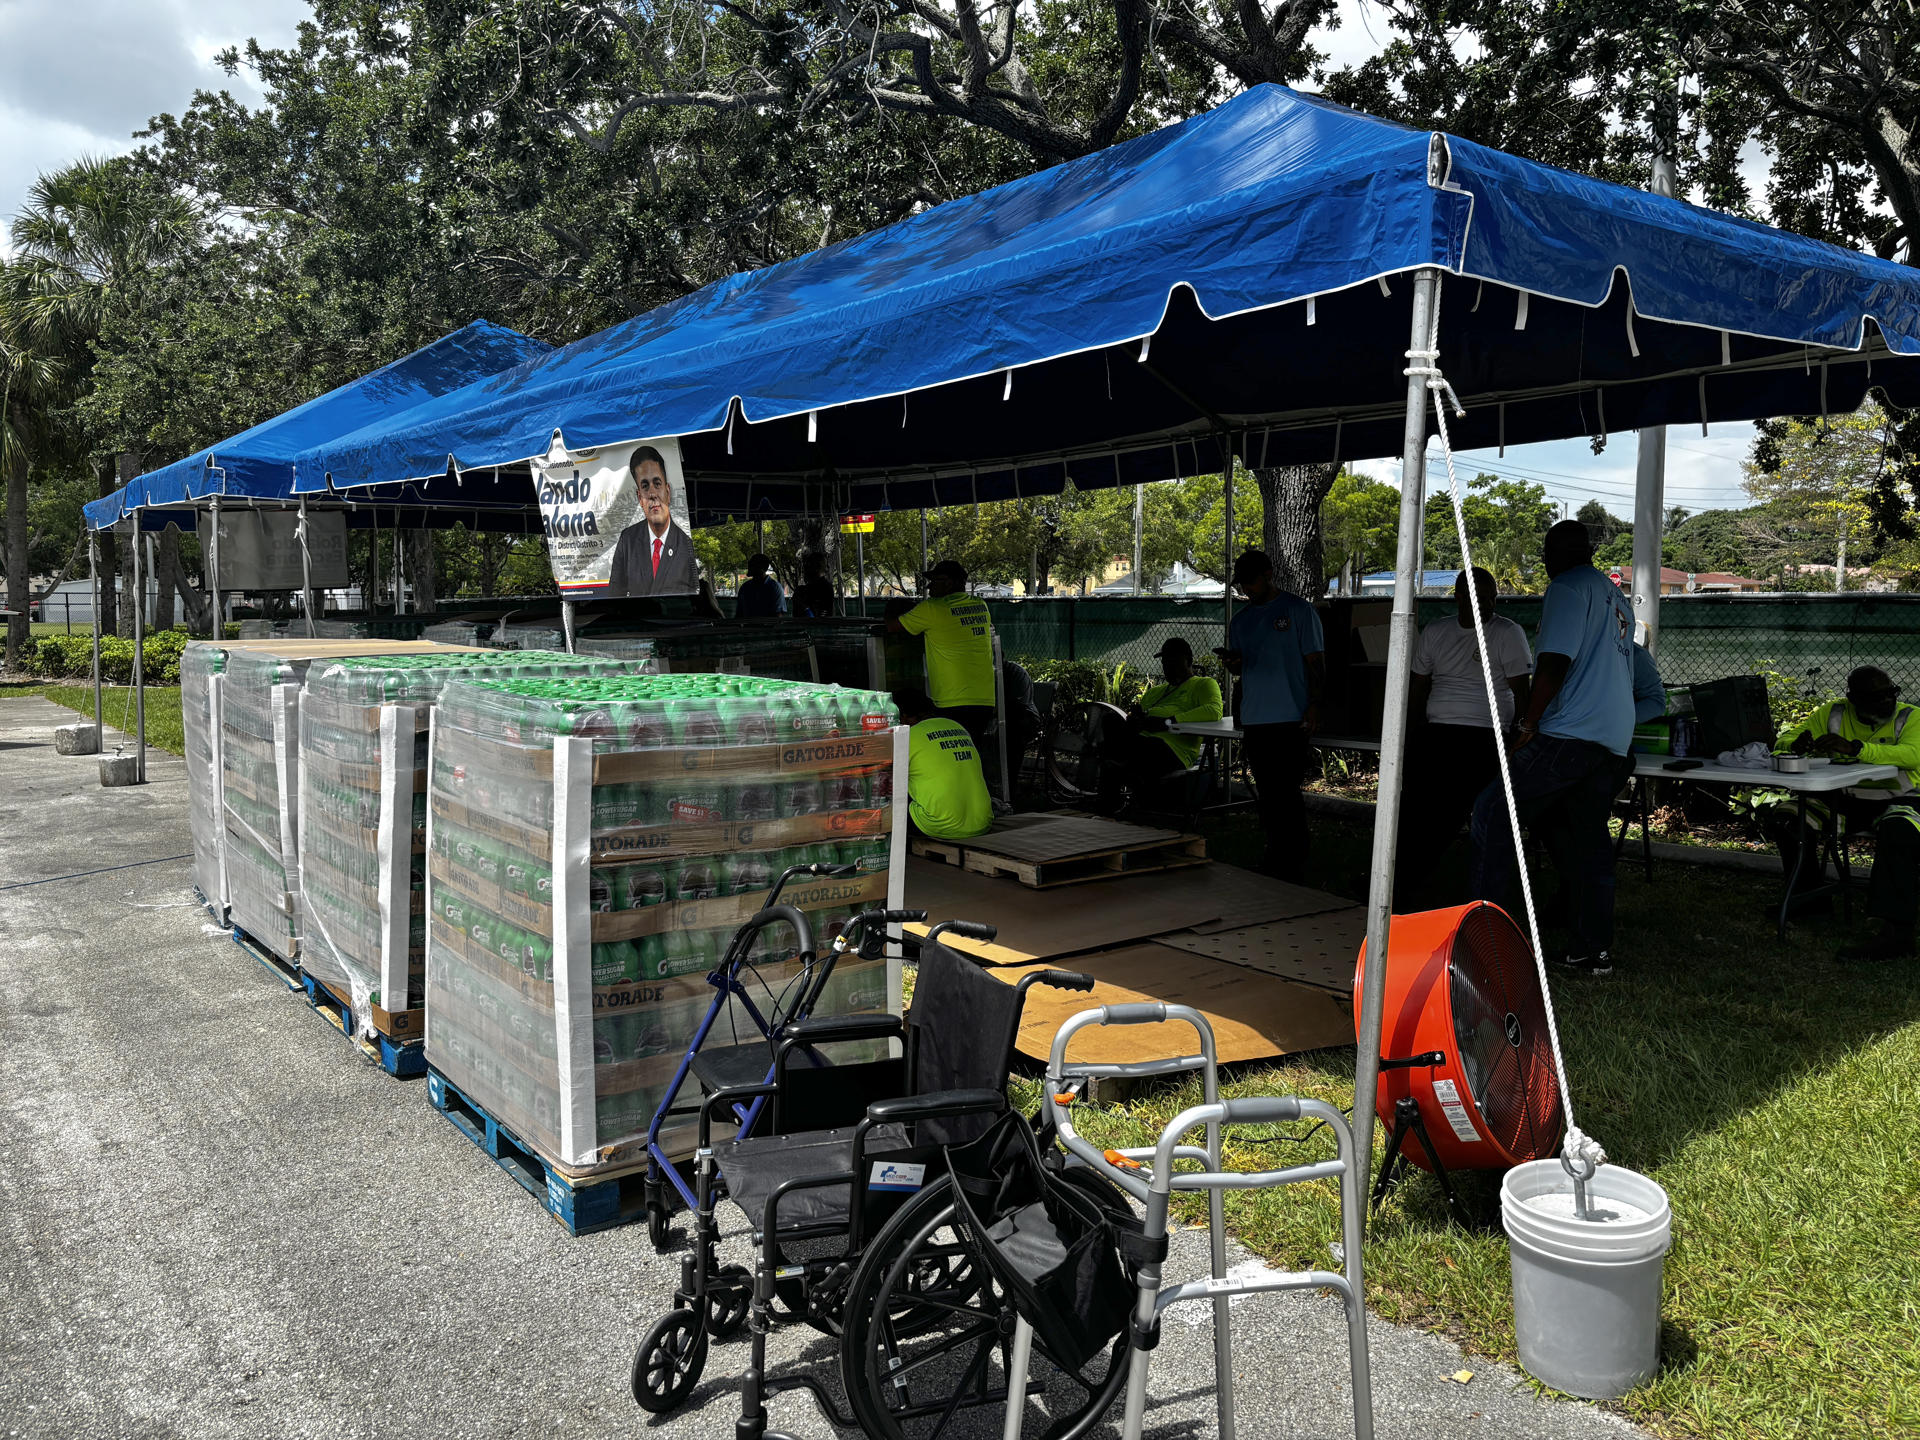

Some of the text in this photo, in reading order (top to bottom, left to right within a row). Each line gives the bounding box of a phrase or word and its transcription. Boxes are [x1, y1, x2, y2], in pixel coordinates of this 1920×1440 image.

[971, 627, 985, 636] TEAM
[784, 743, 864, 764] GATORADE
[953, 751, 972, 761] TEAM
[591, 833, 671, 851] ATORADE
[781, 884, 864, 905] GATORADE
[592, 987, 664, 1008] TORADE
